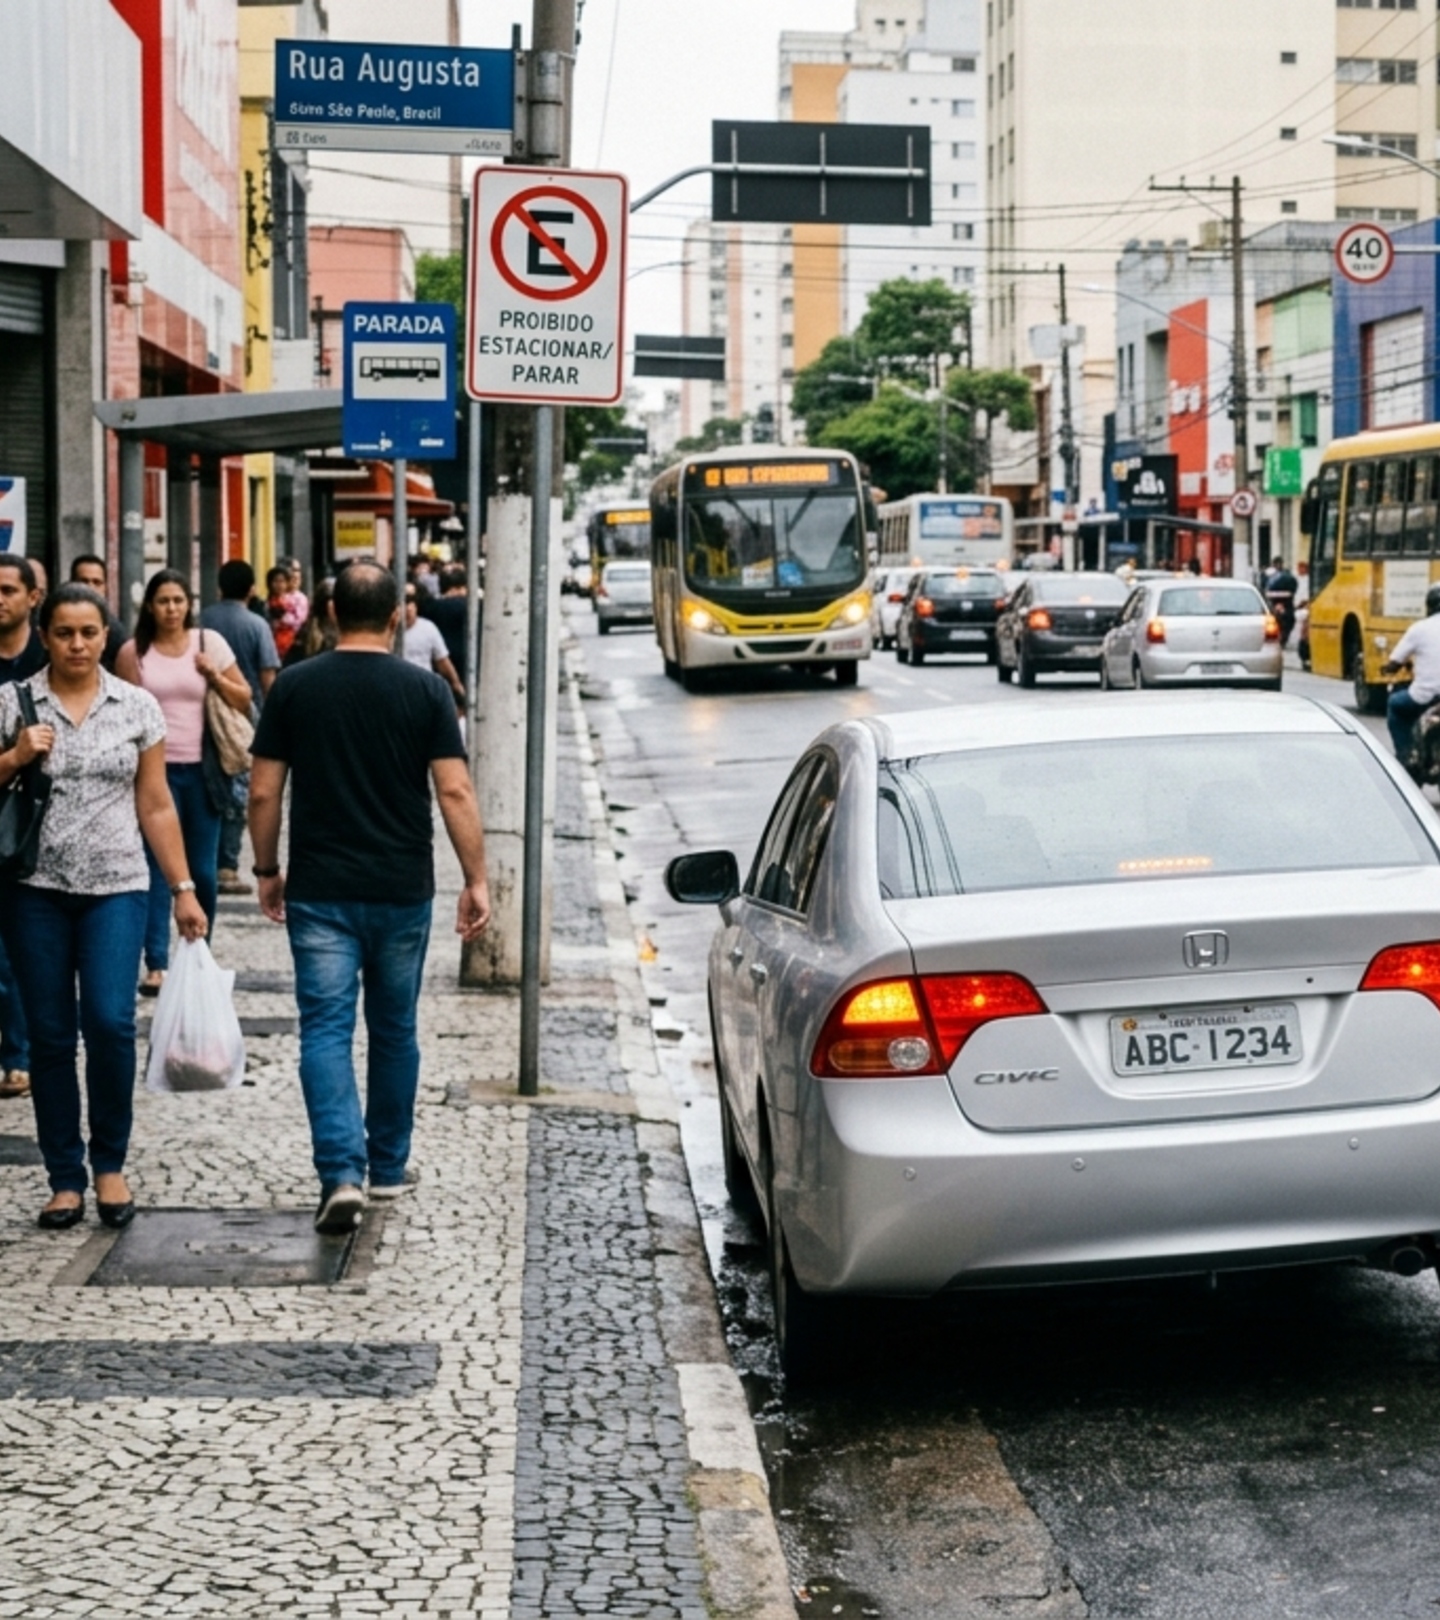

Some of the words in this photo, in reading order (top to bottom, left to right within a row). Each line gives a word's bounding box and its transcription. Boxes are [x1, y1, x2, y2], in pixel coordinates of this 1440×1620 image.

[289, 50, 344, 80] Rua
[357, 52, 480, 91] Augusta
[1346, 237, 1383, 259] 40
[354, 314, 445, 334] PARADA
[499, 310, 594, 333] PROIBIDO
[479, 335, 614, 359] ESTACIONAR/
[512, 364, 579, 384] PARAR
[1125, 1025, 1292, 1067] ABC-1234
